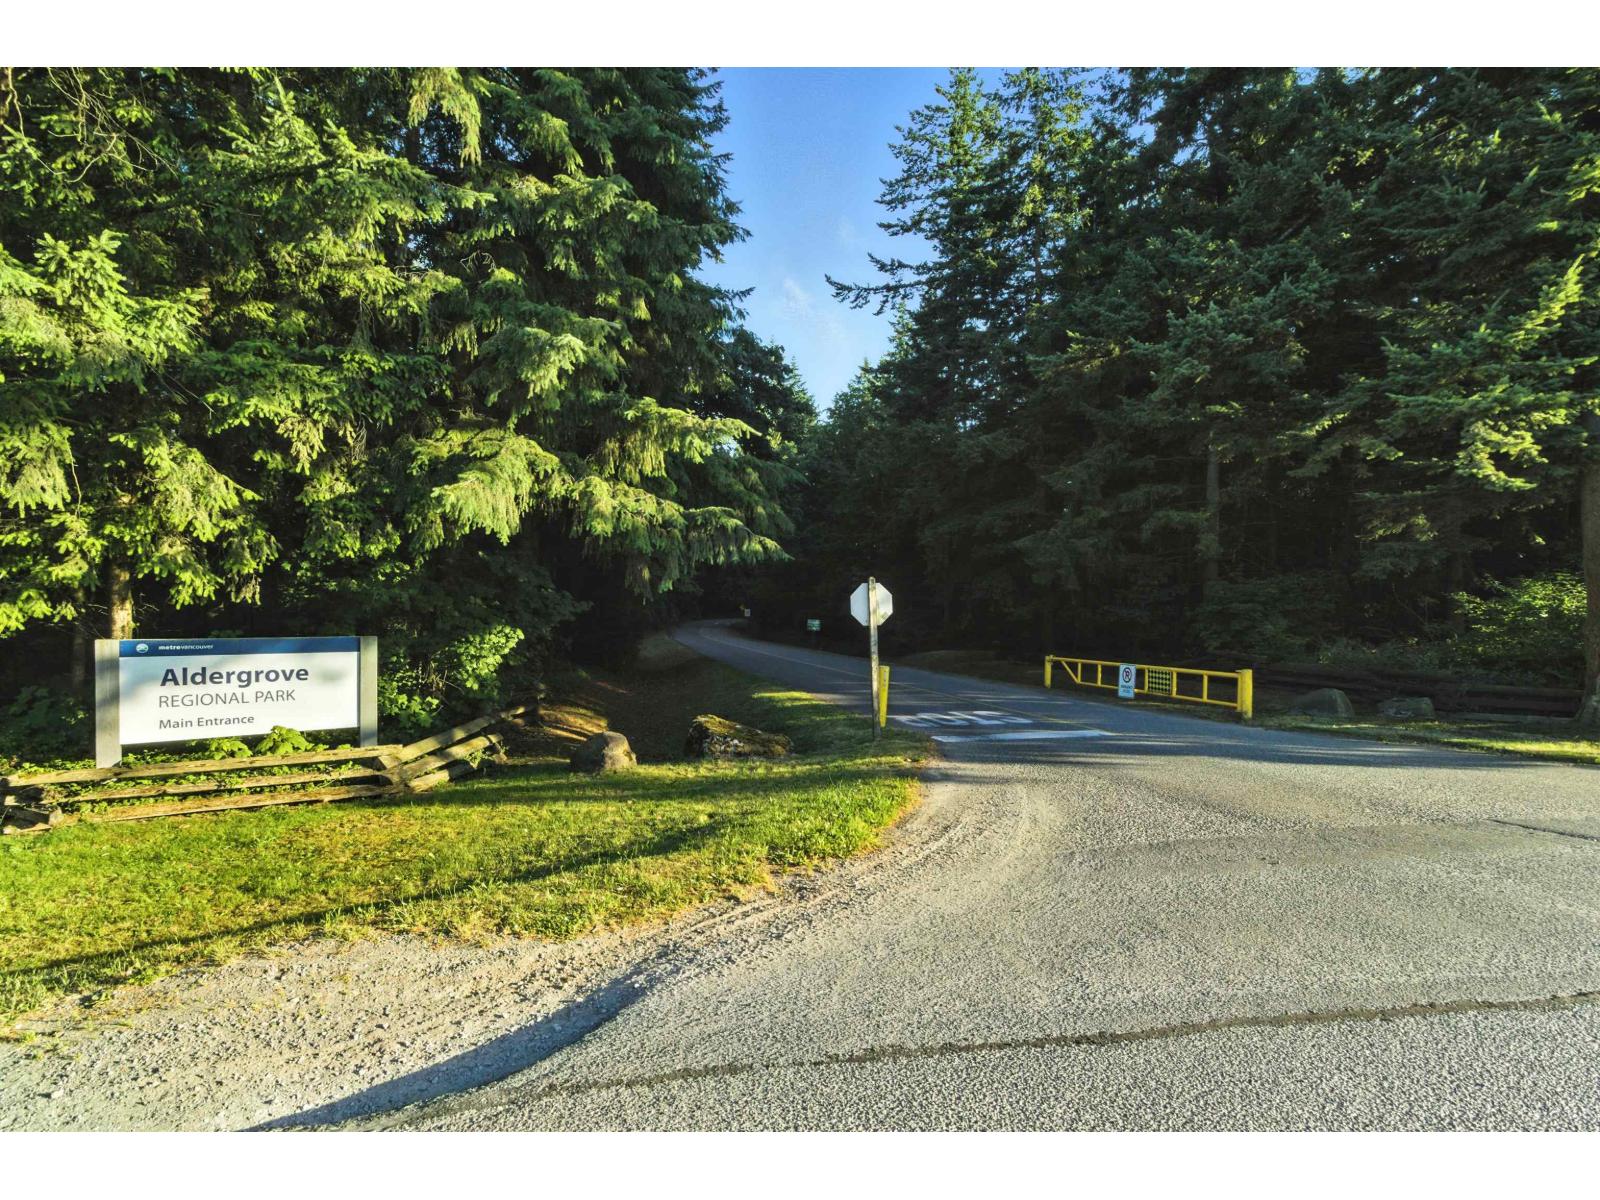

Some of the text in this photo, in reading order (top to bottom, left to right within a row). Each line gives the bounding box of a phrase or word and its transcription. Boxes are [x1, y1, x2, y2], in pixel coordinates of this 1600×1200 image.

[160, 666, 309, 688] Aldergrove
[158, 689, 296, 708] REGIONAL PARK
[159, 715, 255, 730] Main Entrance
